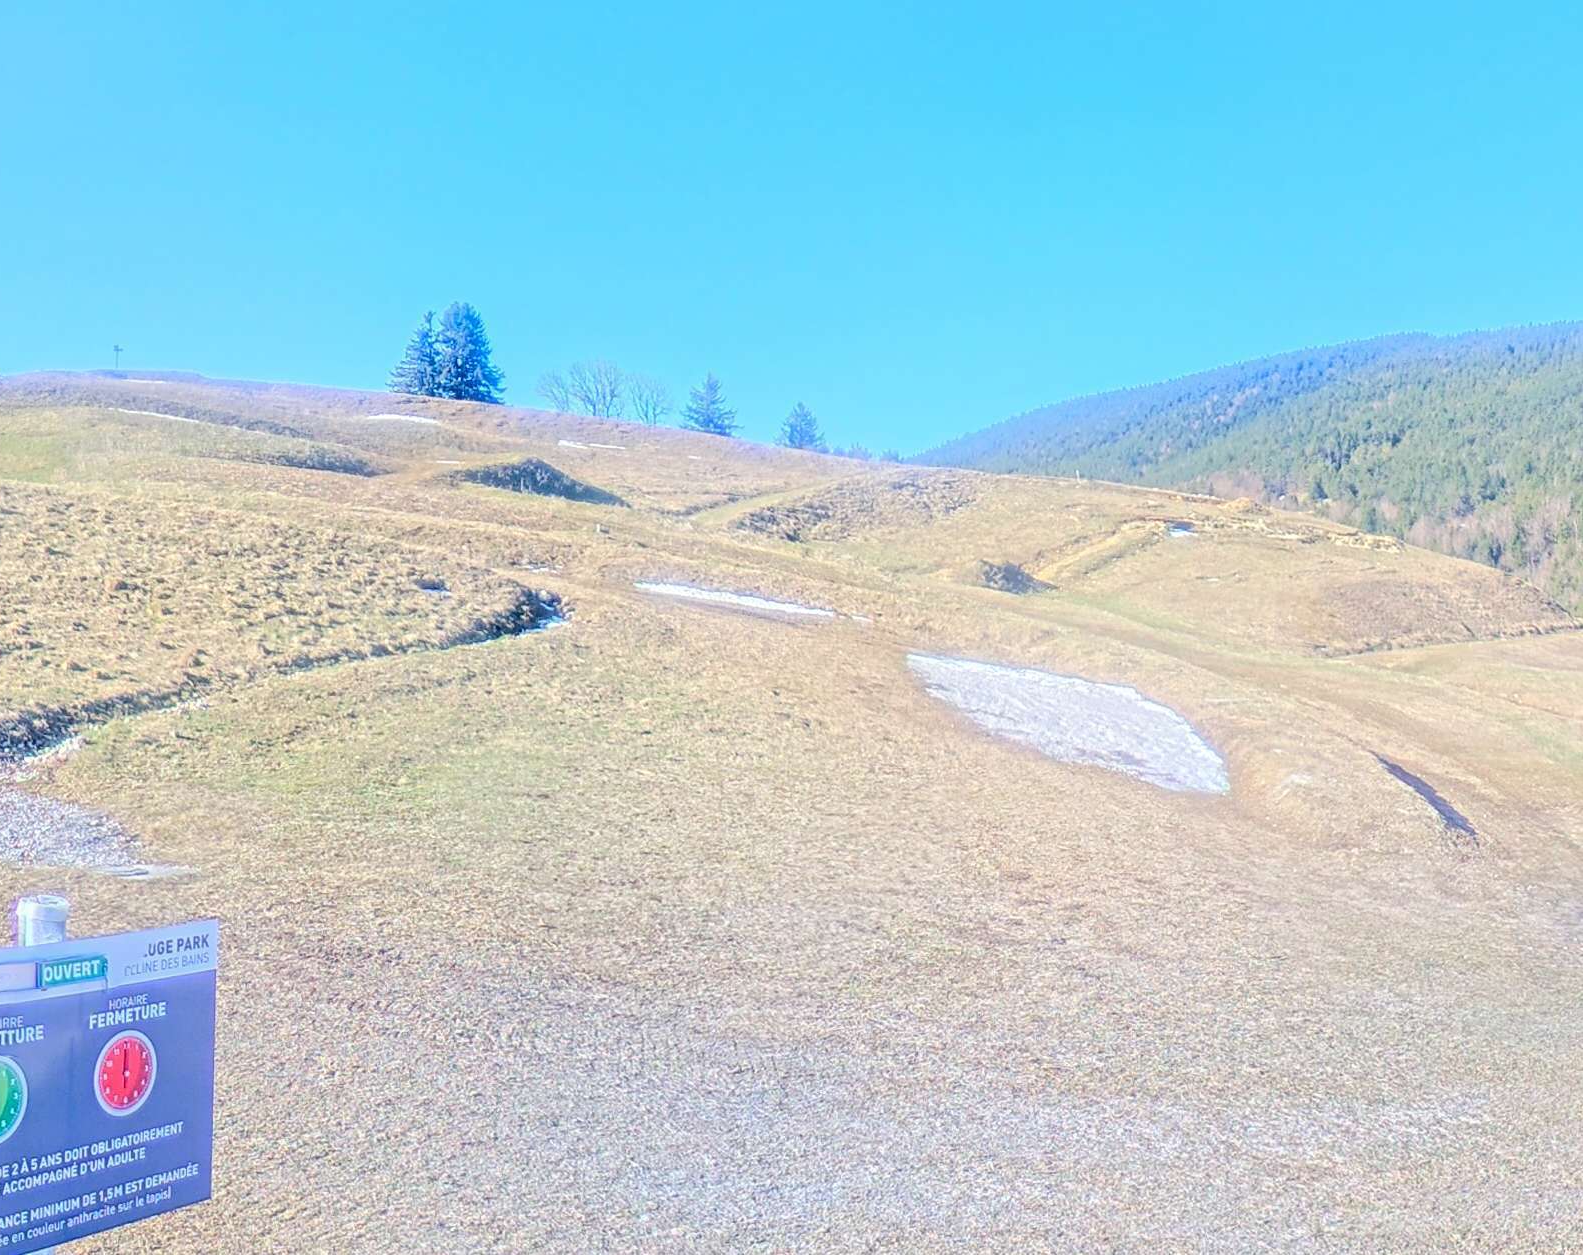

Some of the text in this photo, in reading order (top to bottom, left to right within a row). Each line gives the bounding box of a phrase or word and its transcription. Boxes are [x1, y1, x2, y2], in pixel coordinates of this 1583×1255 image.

[177, 934, 210, 952] PARK
[43, 959, 100, 982] OUVERT
[161, 957, 179, 970] DES
[182, 952, 210, 967] BAINS
[89, 1002, 167, 1030] FERMETURE
[109, 993, 148, 1011] HORAIRE
[12, 1163, 19, 1176] 2
[20, 1157, 30, 1174] À
[31, 1158, 38, 1171] 5
[39, 1152, 62, 1169] ANS
[64, 1145, 90, 1162] DOIT
[91, 1121, 184, 1155] OBLIGATOIREMENT
[2, 1162, 78, 1196] ACCOMPAGNÉ
[80, 1158, 105, 1175] D'UN
[107, 1147, 146, 1168] ADULTE
[30, 1197, 80, 1221] MINIMUM
[82, 1192, 97, 1207] DE
[125, 1179, 144, 1195] EST
[145, 1162, 199, 1189] DEMANDÉE
[11, 1231, 26, 1244] en
[27, 1219, 65, 1239] couleur
[67, 1204, 116, 1228] anthracite
[117, 1199, 134, 1213] sur
[136, 1195, 145, 1208] le
